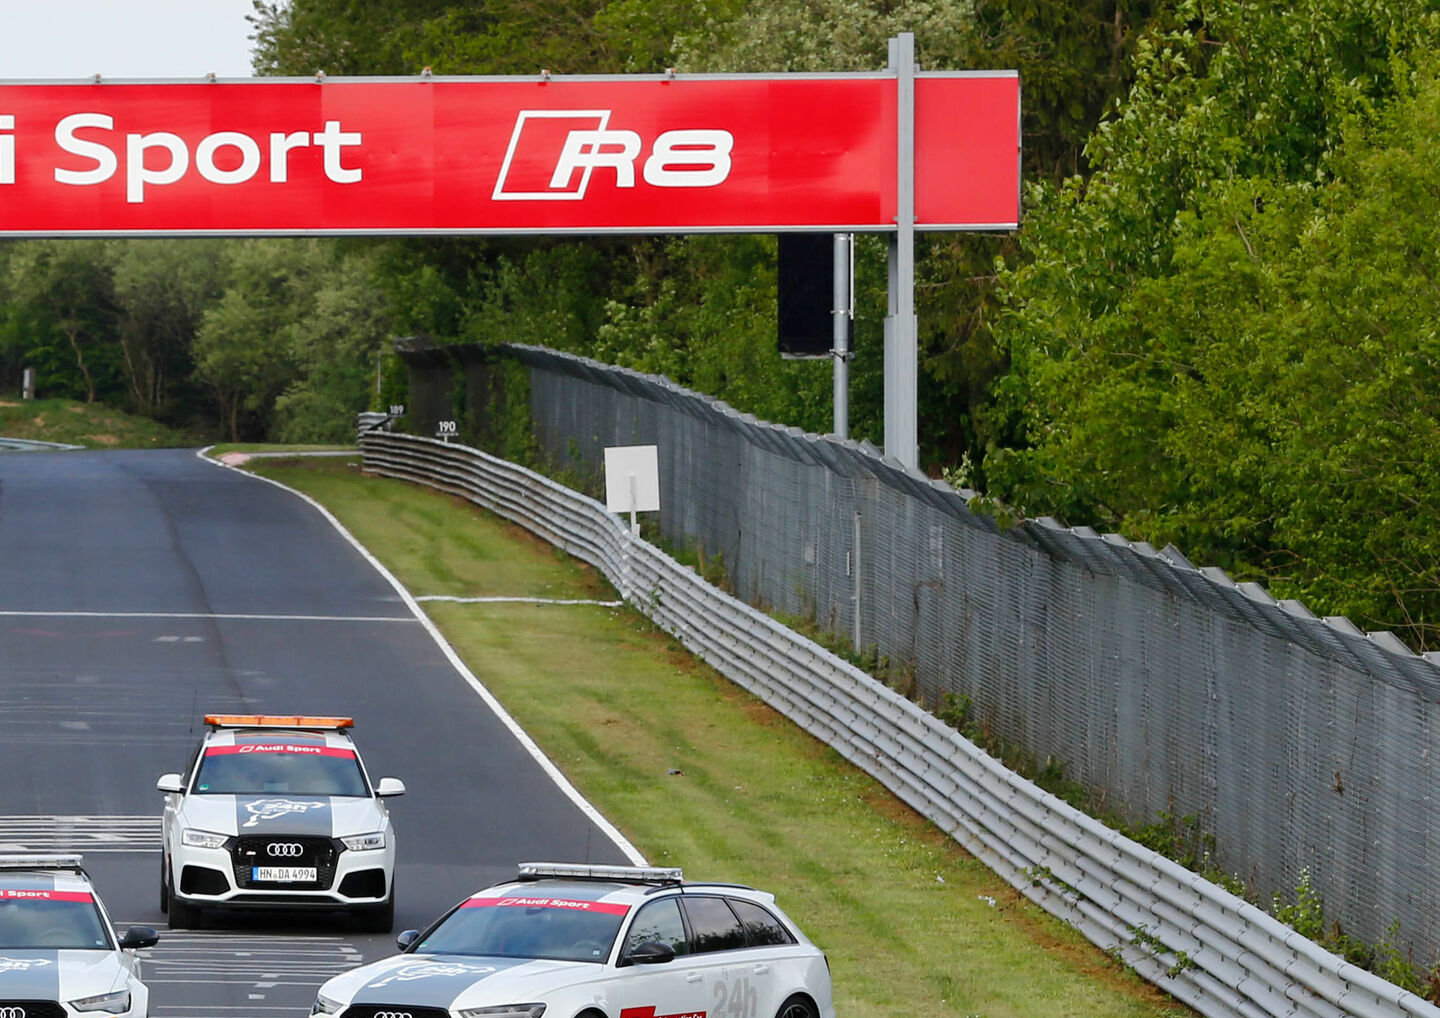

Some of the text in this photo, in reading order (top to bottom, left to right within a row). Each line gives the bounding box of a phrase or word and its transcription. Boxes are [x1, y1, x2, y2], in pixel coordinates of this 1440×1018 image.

[53, 112, 364, 204] Sport
[550, 129, 734, 189] R8
[438, 420, 457, 432] 190
[259, 869, 315, 879] HN DA 4994
[7, 890, 50, 898] Sport
[516, 898, 590, 909] Audi Sport
